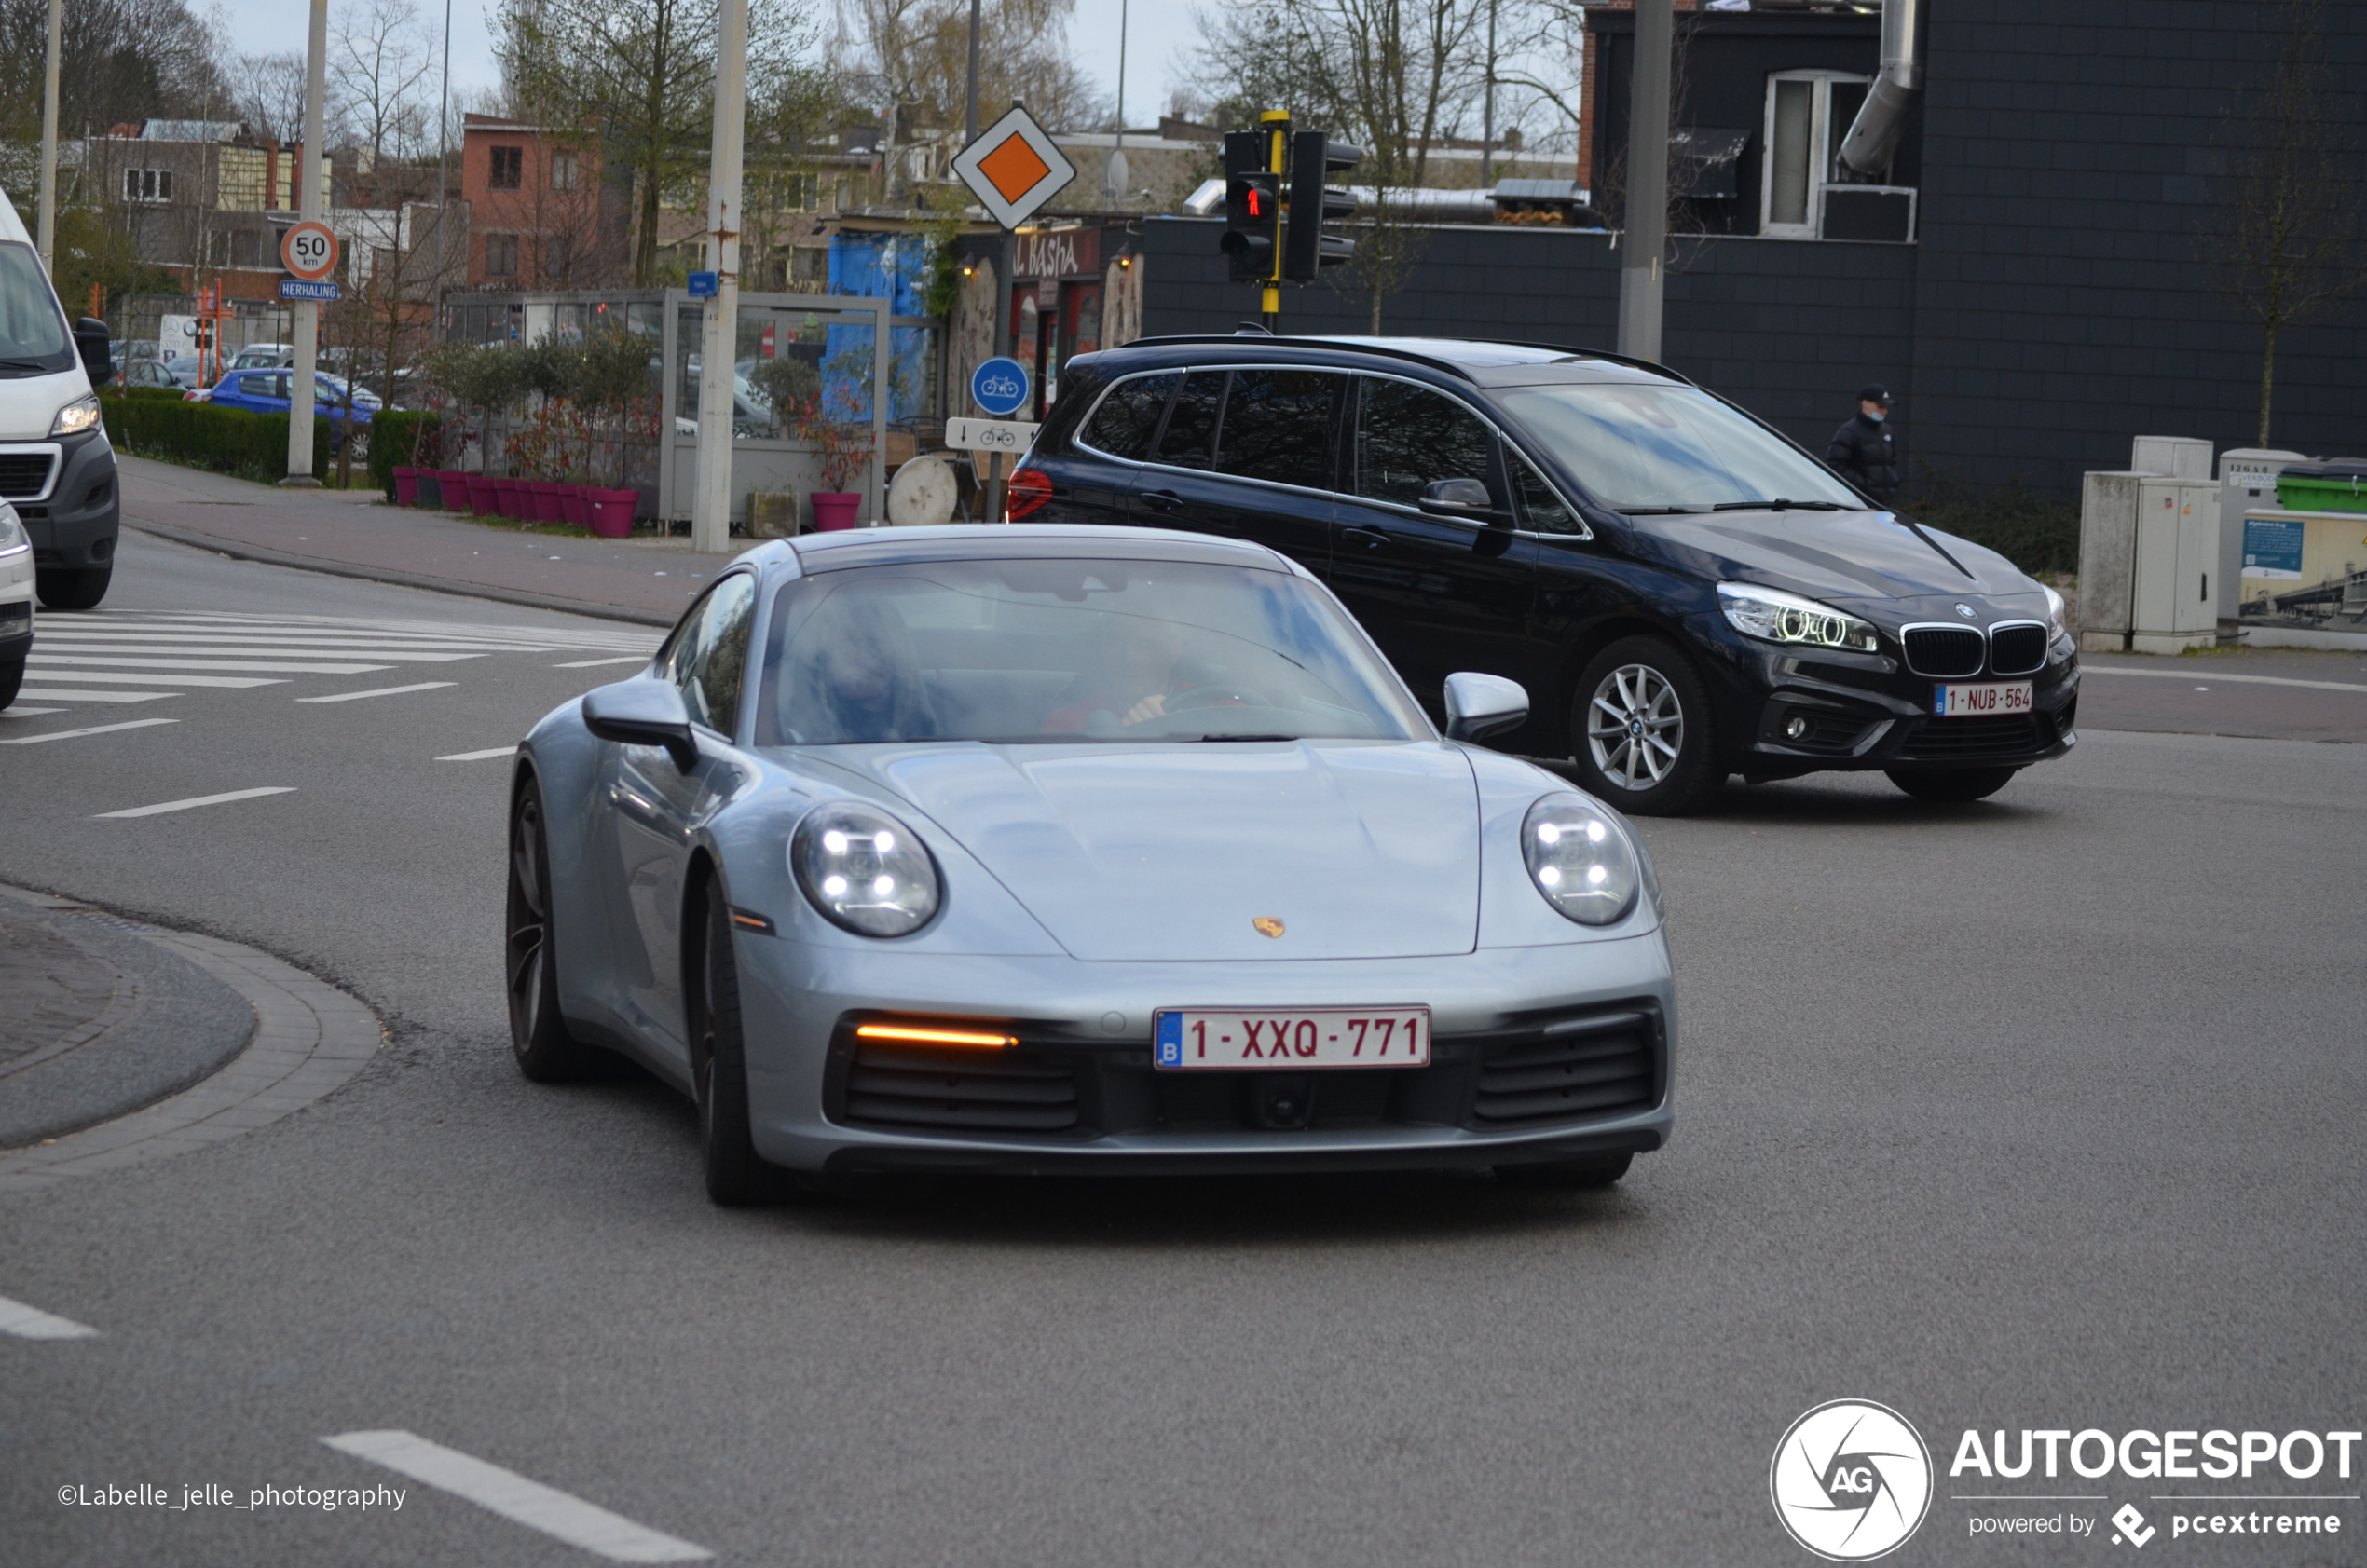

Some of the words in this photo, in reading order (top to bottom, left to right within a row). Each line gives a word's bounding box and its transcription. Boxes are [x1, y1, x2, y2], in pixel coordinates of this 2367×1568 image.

[296, 237, 325, 257] 50
[303, 257, 318, 266] km
[282, 282, 336, 298] HERHALING
[1936, 702, 1944, 713] B
[1950, 687, 2031, 711] 1-NUB-564
[1162, 1043, 1178, 1062] B
[1191, 1017, 1417, 1058] 1-XXQ-771
